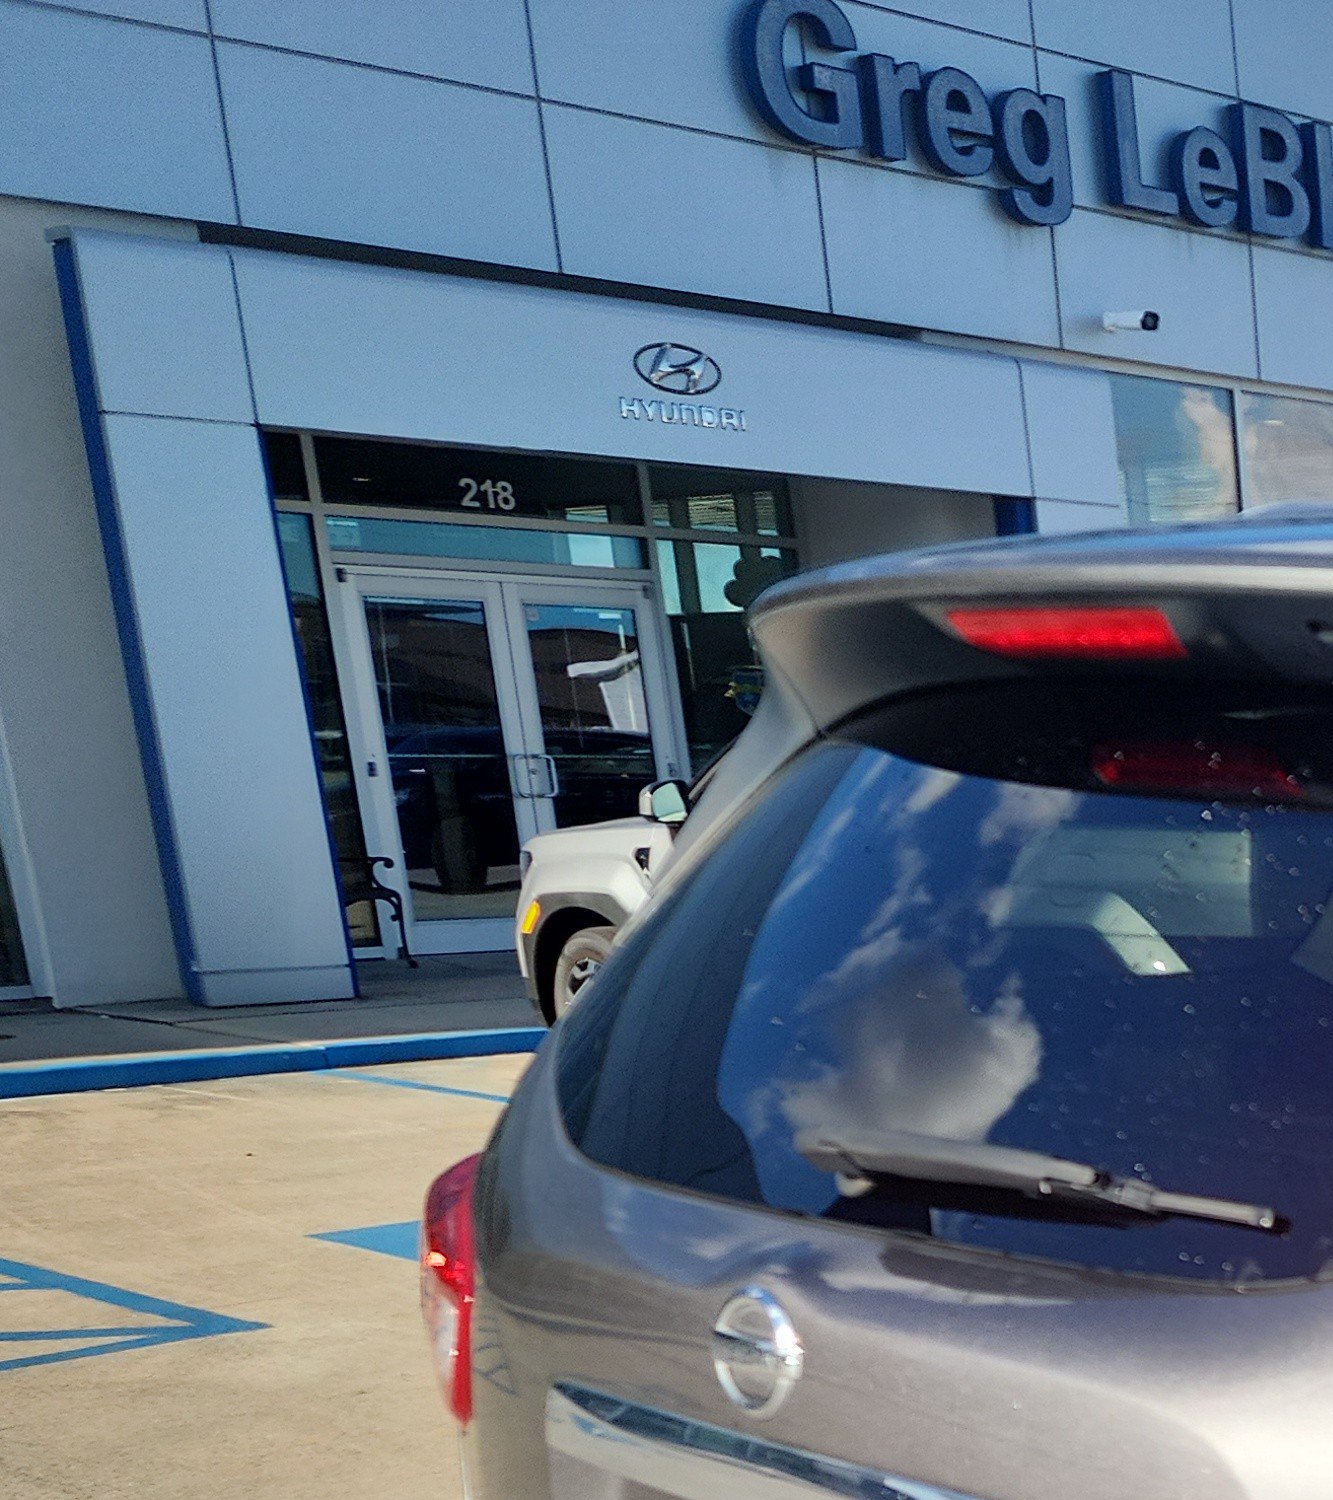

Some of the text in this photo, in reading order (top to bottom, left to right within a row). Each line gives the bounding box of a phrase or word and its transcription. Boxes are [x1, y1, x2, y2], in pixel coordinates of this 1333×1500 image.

[736, 0, 1073, 227] Greg
[618, 396, 747, 432] HYUNDAI
[457, 477, 516, 511] 218
